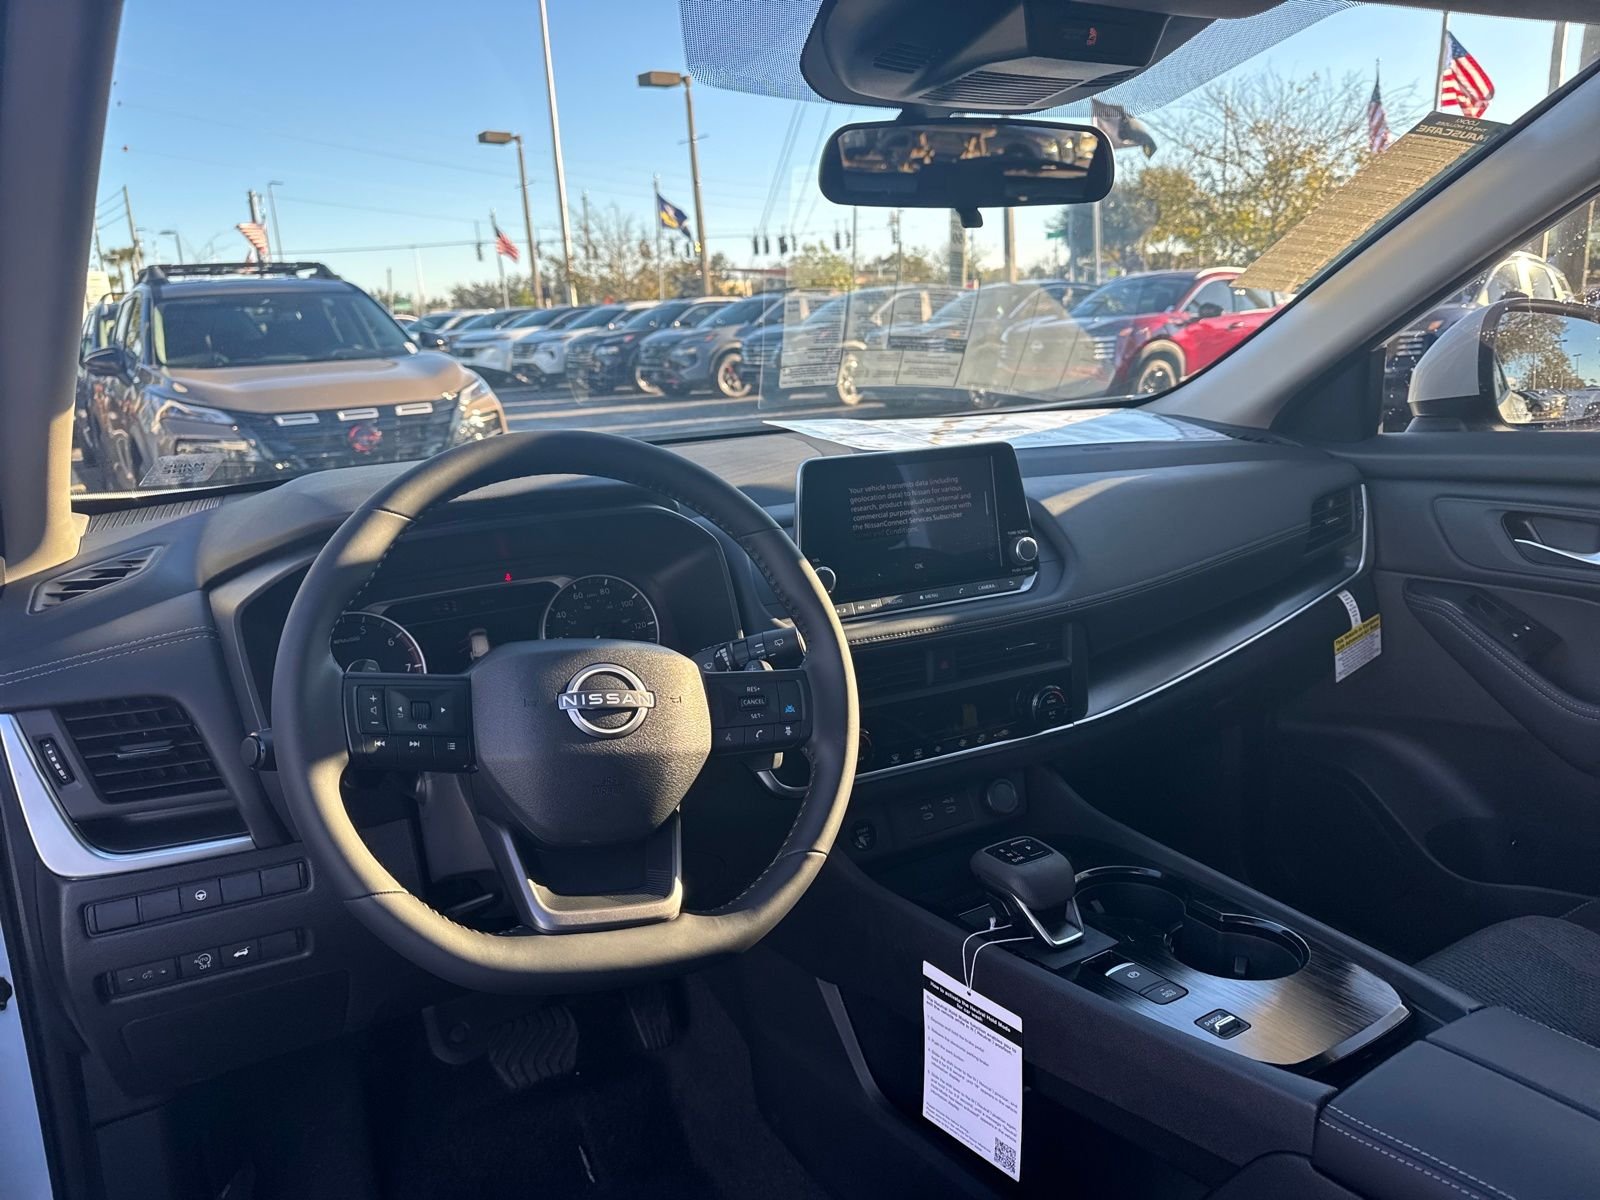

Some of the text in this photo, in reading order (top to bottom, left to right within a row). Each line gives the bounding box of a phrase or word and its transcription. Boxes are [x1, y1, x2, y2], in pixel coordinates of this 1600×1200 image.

[572, 592, 583, 600] 60
[600, 588, 610, 596] 80
[621, 600, 634, 608] 100
[555, 611, 567, 619] 40
[360, 625, 367, 635] 5
[387, 636, 395, 647] 6
[404, 663, 412, 673] 7
[562, 693, 653, 707] NISSAN
